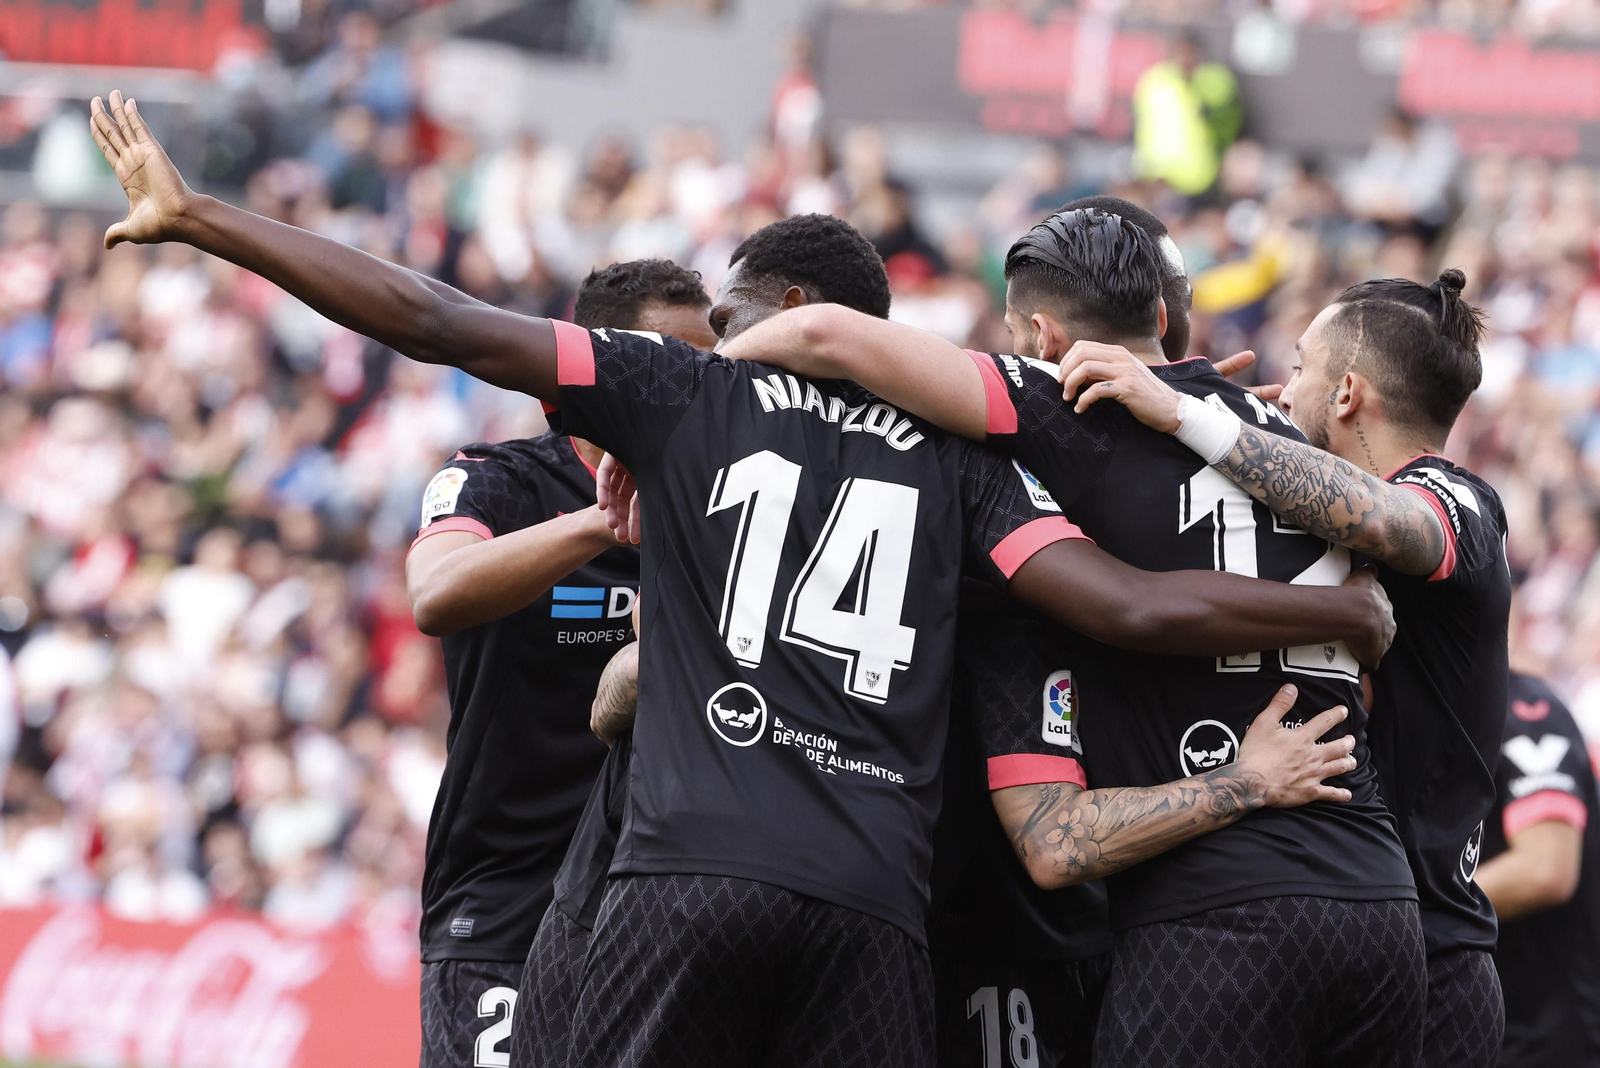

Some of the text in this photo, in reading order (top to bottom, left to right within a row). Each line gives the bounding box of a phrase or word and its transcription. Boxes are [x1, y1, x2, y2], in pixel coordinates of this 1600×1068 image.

[706, 449, 920, 705] 14
[772, 730, 791, 745] DE
[806, 748, 825, 764] DE
[827, 754, 905, 784] ALIMENTOS
[474, 986, 519, 1068] 2
[966, 986, 1040, 1068] 18
